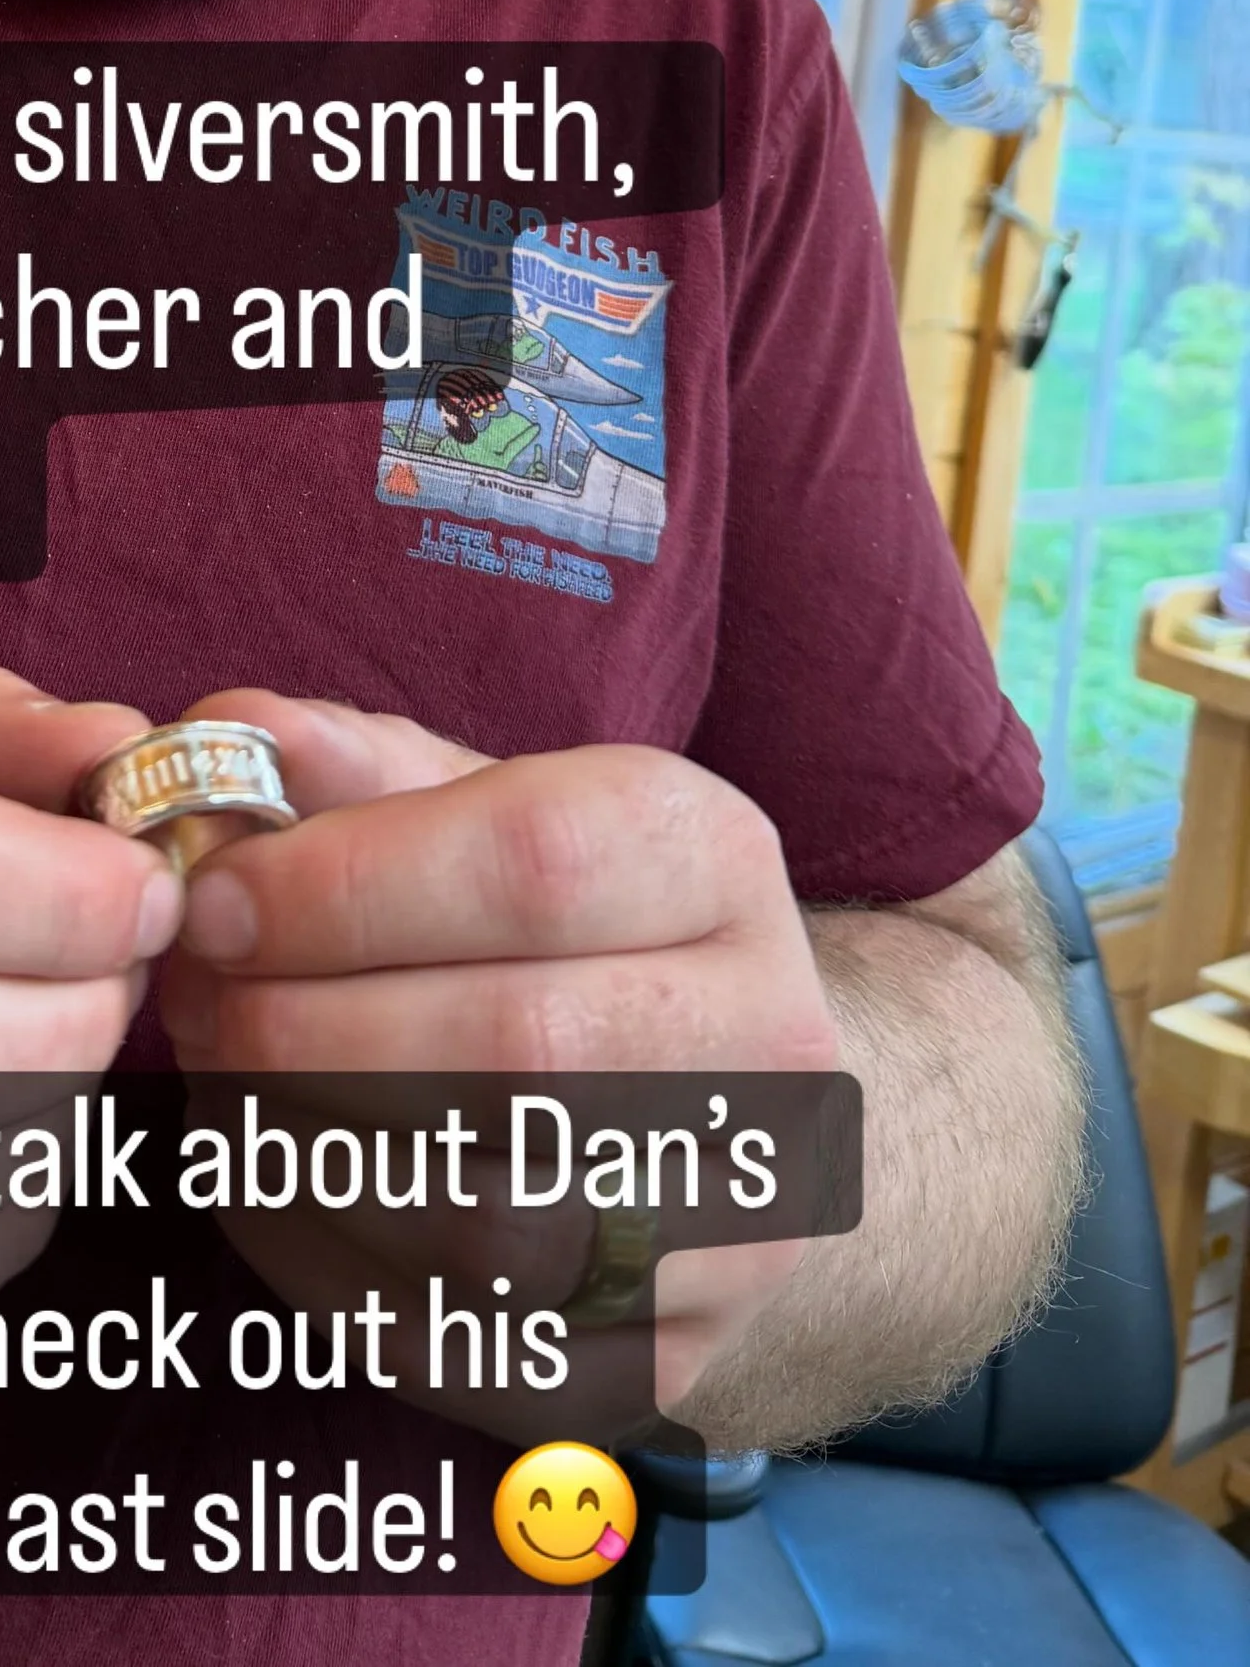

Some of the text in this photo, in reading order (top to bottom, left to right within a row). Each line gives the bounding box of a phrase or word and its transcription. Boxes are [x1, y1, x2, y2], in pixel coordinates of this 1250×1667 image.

[405, 184, 659, 274] WEIRD FISH
[457, 244, 596, 311] TOP GUDGEON
[461, 548, 506, 575] NEED
[509, 560, 542, 584] FOR
[501, 536, 546, 565] THE
